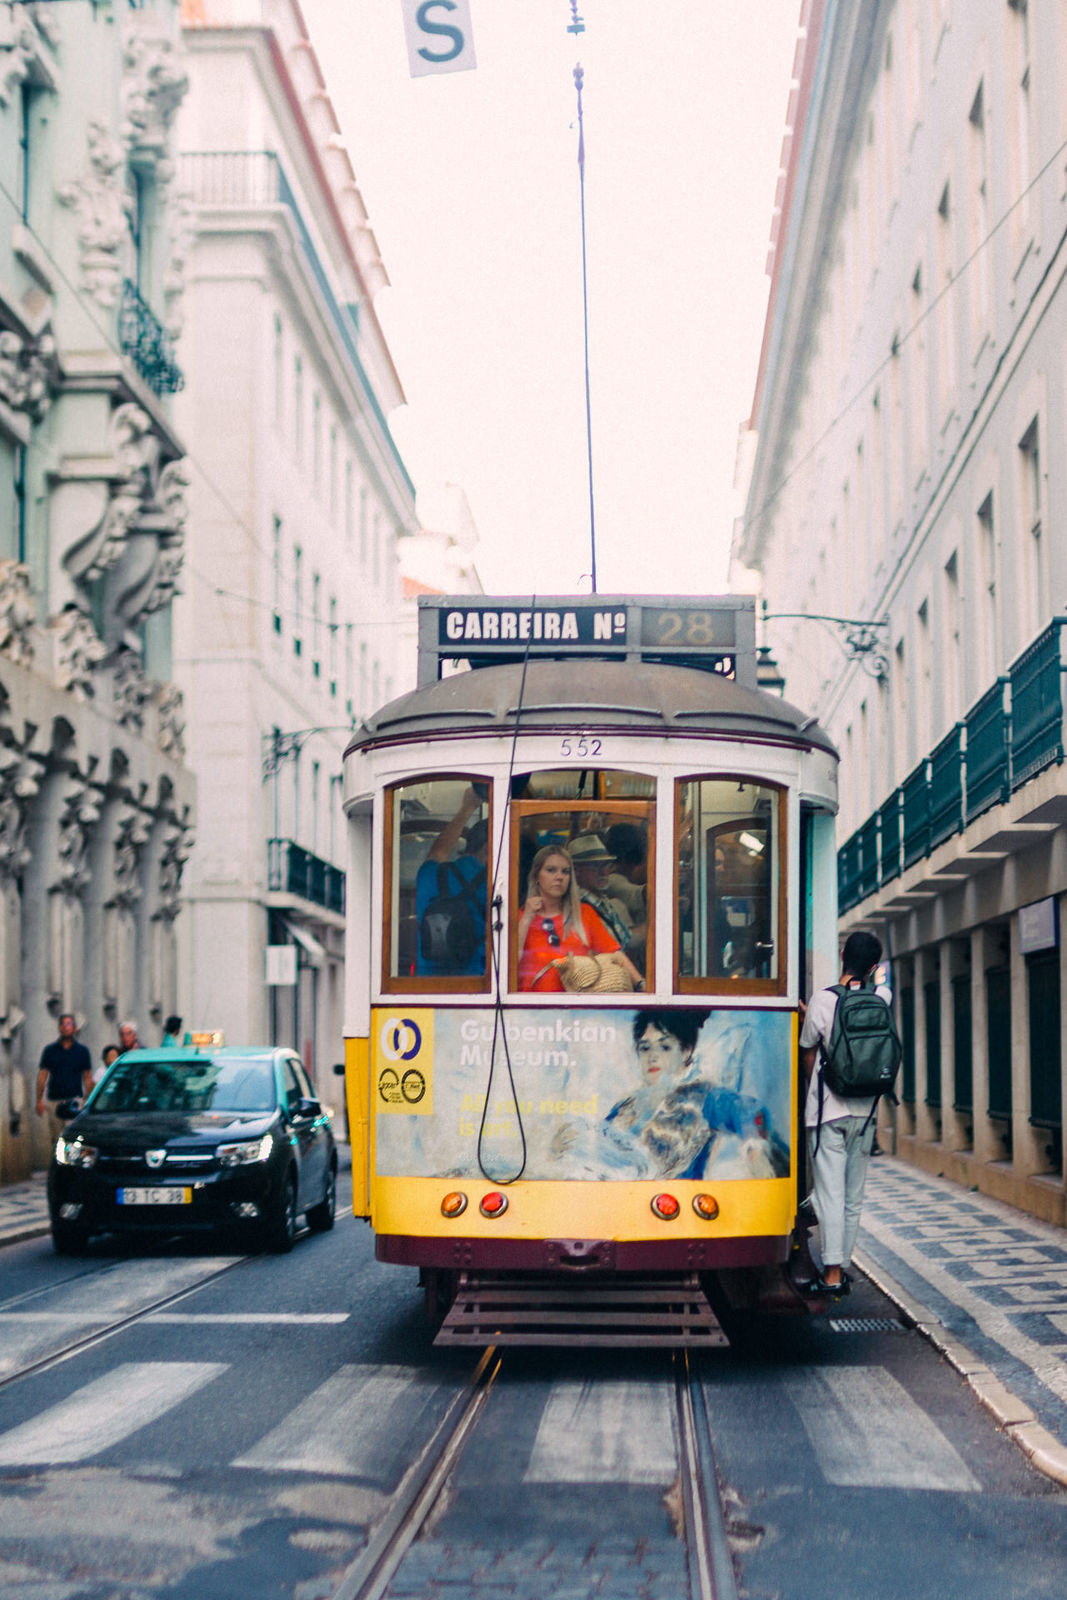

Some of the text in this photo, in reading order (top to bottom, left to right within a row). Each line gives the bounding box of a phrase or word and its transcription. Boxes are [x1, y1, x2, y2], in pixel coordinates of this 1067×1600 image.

[416, 0, 464, 62] S
[446, 612, 579, 640] CARREIRA
[658, 610, 713, 646] 28
[560, 738, 602, 757] 552
[495, 1099, 533, 1118] you
[540, 1094, 599, 1115] need
[459, 1117, 475, 1137] is
